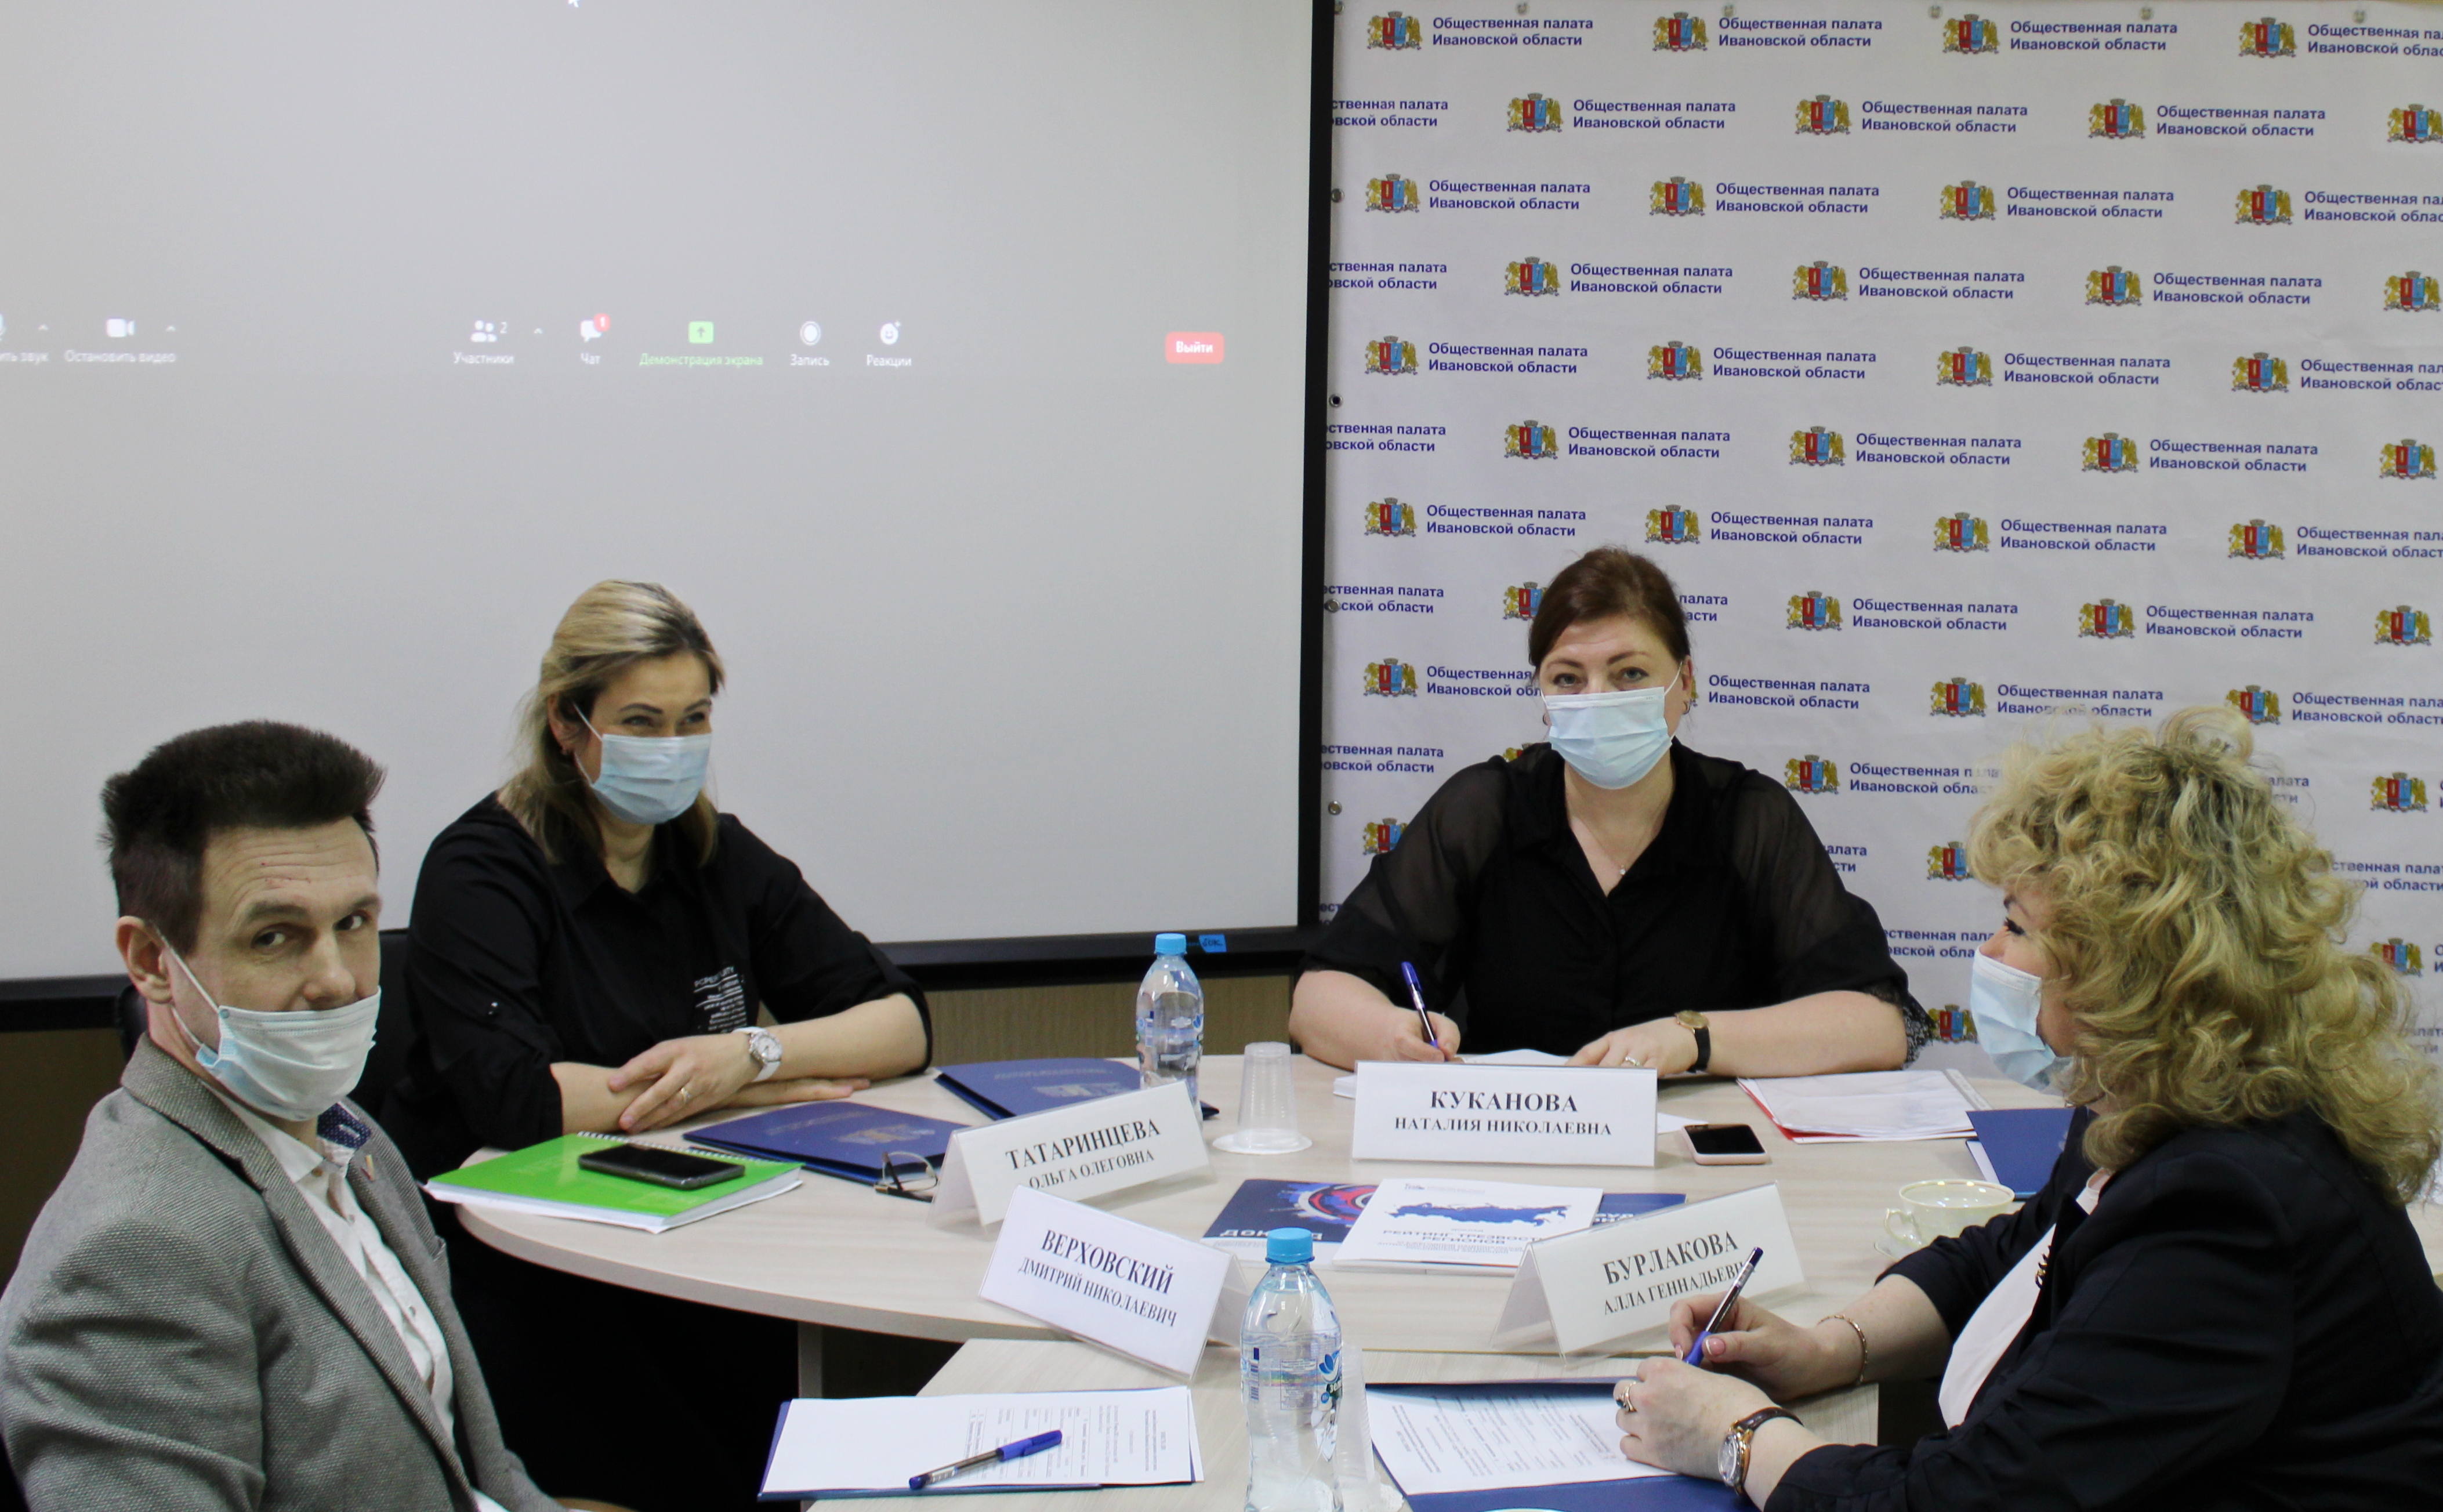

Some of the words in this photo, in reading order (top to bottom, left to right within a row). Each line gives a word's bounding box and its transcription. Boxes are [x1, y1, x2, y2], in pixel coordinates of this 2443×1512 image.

[1433, 16, 1539, 31] Общественная
[1543, 19, 1593, 29] палата
[1719, 17, 1827, 30] Общественная
[1831, 20, 1883, 30] палата
[2011, 20, 2122, 34] Общественная
[2126, 23, 2178, 33] палата
[2308, 23, 2420, 38] Общественная
[1432, 33, 1518, 46] Ивановской
[1522, 32, 1582, 46] области
[1719, 34, 1806, 46] Ивановской
[1810, 34, 1872, 46] области
[2010, 38, 2101, 50] Ивановской
[2104, 38, 2167, 50] области
[2308, 41, 2399, 54] Ивановской
[1399, 100, 1448, 110] палата
[1573, 99, 1681, 113] Общественная
[1686, 102, 1736, 113] палата
[1861, 100, 1973, 115] Общественная
[1977, 106, 2028, 116] палата
[2158, 104, 2269, 119] Общественная
[2274, 109, 2326, 119] палата
[1380, 114, 1438, 127] области
[1573, 115, 1661, 129] Ивановской
[1665, 116, 1725, 129] области
[1861, 118, 1951, 132] Ивановской
[1955, 119, 2017, 133] области
[2157, 122, 2248, 136] Ивановской
[2252, 123, 2314, 136] области
[1429, 179, 1536, 194] Общественная
[1540, 183, 1590, 194] палата
[1716, 182, 1825, 197] Общественная
[1829, 186, 1880, 197] палата
[2007, 186, 2119, 201] Общественная
[2123, 191, 2174, 201] палата
[1429, 196, 1516, 209] Ивановской
[1519, 197, 1579, 210] области
[2304, 190, 2418, 205] Общественная
[1716, 199, 1804, 213] Ивановской
[1808, 200, 1868, 213] области
[2007, 204, 2097, 217] Ивановской
[2101, 205, 2163, 218] области
[2305, 208, 2397, 222] Ивановской
[1398, 263, 1447, 273] палата
[1570, 262, 1679, 278] Общественная
[1683, 267, 1733, 277] палата
[1859, 266, 1970, 281] Общественная
[1974, 272, 2025, 282] палата
[1378, 277, 1437, 290] области
[1570, 280, 1658, 293] Ивановской
[1662, 281, 1722, 294] области
[2154, 272, 2266, 287] Общественная
[2270, 277, 2322, 288] палата
[1859, 284, 1948, 298] Ивановской
[1952, 286, 2014, 299] области
[2153, 289, 2244, 303] Ивановской
[2249, 291, 2311, 304] области
[500, 322, 507, 333] 2
[1176, 341, 1213, 353] Выйти
[1428, 342, 1534, 357] Общественная
[1538, 347, 1588, 357] палата
[1713, 347, 1822, 362] Общественная
[1826, 352, 1877, 362] палата
[64, 350, 136, 362] Остановить
[139, 353, 175, 364] видео
[454, 352, 514, 364] Участники
[581, 353, 600, 364] Чат
[639, 353, 722, 367] Демонстрация
[725, 356, 763, 367] экрана
[790, 354, 829, 367] Запись
[867, 355, 912, 368] Реакции
[2004, 352, 2116, 368] Общественная
[2119, 358, 2171, 368] палата
[1429, 358, 1514, 372] Ивановской
[1517, 360, 1577, 374] области
[1713, 364, 1801, 378] Ивановской
[1804, 366, 1865, 379] области
[2300, 358, 2414, 374] Общественная
[2004, 369, 2094, 384] Ивановской
[2098, 372, 2160, 385] области
[2301, 376, 2392, 390] Ивановской
[1397, 425, 1447, 436] палата
[1568, 426, 1677, 441] Общественная
[1681, 431, 1731, 442] палата
[1378, 438, 1436, 452] области
[1855, 432, 1967, 448] Общественная
[1970, 438, 2022, 448] палата
[2150, 438, 2262, 454] Общественная
[2266, 444, 2319, 455] палата
[1568, 443, 1656, 457] Ивановской
[1660, 445, 1720, 459] области
[1856, 449, 1945, 464] Ивановской
[1949, 452, 2011, 465] области
[2150, 456, 2241, 470] Ивановской
[2244, 458, 2307, 472] области
[1426, 504, 1534, 519] Общественная
[1537, 509, 1586, 521] палата
[1710, 511, 1819, 527] Общественная
[1823, 517, 1873, 528] палата
[1426, 521, 1514, 535] Ивановской
[1517, 523, 1576, 537] области
[2000, 518, 2112, 534] Общественная
[2116, 524, 2167, 535] палата
[2297, 525, 2410, 541] Общественная
[1710, 528, 1798, 543] Ивановской
[1802, 531, 1862, 545] области
[2000, 536, 2090, 550] Ивановской
[2094, 538, 2156, 552] области
[2297, 543, 2388, 557] Ивановской
[1398, 586, 1444, 598] палата
[1378, 600, 1434, 614] области
[1853, 597, 1963, 613] Общественная
[1967, 604, 2018, 614] палата
[2146, 605, 2258, 620] Общественная
[2262, 611, 2315, 622] палата
[1853, 615, 1942, 629] Ивановской
[1946, 617, 2007, 630] области
[2146, 622, 2237, 637] Ивановской
[2241, 625, 2303, 639] области
[1426, 665, 1534, 681] Общественная
[1427, 681, 1512, 697] Ивановской
[1708, 674, 1816, 693] Общественная
[1820, 681, 1871, 693] палата
[1997, 683, 2108, 699] Общественная
[2112, 690, 2164, 701] палата
[2293, 691, 2405, 707] Общественная
[1708, 691, 1795, 707] Ивановской
[1799, 691, 1860, 709] области
[2292, 709, 2383, 723] Ивановской
[1397, 746, 1444, 758] палата
[1376, 760, 1434, 774] области
[1850, 762, 1960, 778] Общественная
[1850, 779, 1939, 794] Ивановской
[1430, 1090, 1578, 1112] КУКАНОВА
[1394, 1117, 1481, 1131] НАТАЛИЯ
[1487, 1120, 1612, 1135] НИКОЛАЕВНА
[1005, 1119, 1161, 1169] ТАТАРИНЦЕВА
[1029, 1168, 1076, 1190] ОЛЬГА
[1080, 1149, 1154, 1177] ОЛЕГОВНА
[1041, 1229, 1175, 1295] ВЕРХОВСКИЙ
[1603, 1231, 1738, 1285] БУРЛАКОВА
[1018, 1257, 1083, 1292] ДМИТРИЙ
[1083, 1280, 1177, 1328] НИКОЛАЕВИЧ
[1605, 1290, 1646, 1315] АЛЛА
[1648, 1261, 1757, 1302] ГЕННАДЬЕВ
